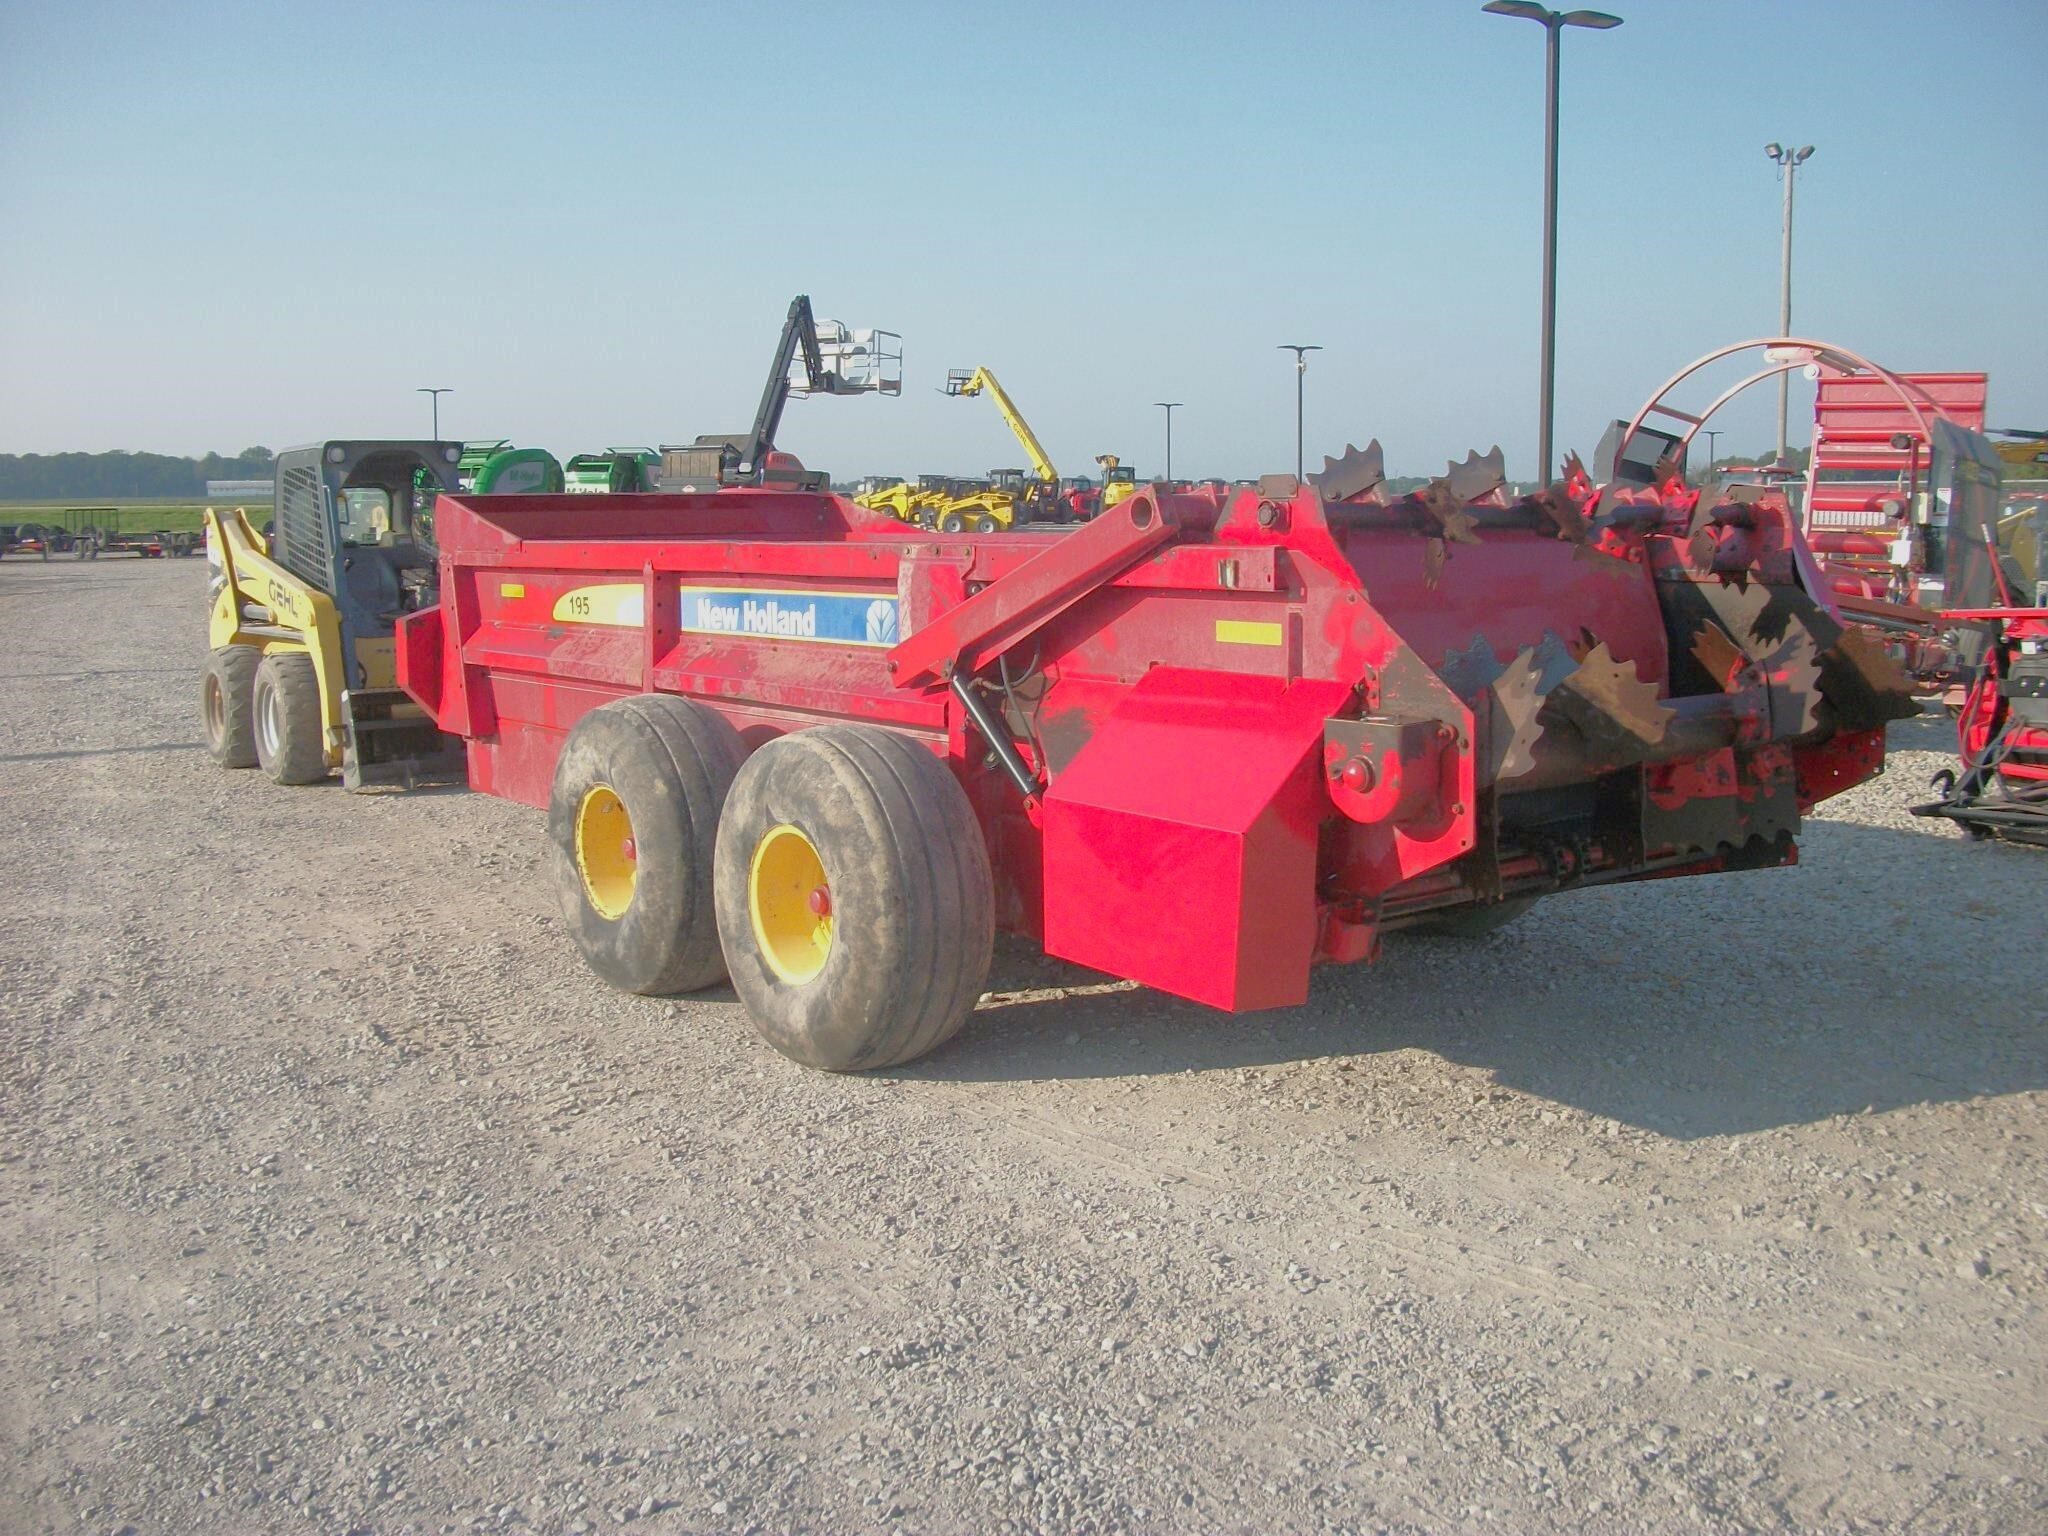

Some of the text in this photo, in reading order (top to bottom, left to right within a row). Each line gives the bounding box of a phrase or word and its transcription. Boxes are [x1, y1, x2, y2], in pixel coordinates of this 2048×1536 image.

[269, 578, 299, 618] GEHL
[569, 595, 590, 616] 195
[697, 598, 816, 637] New Holland
